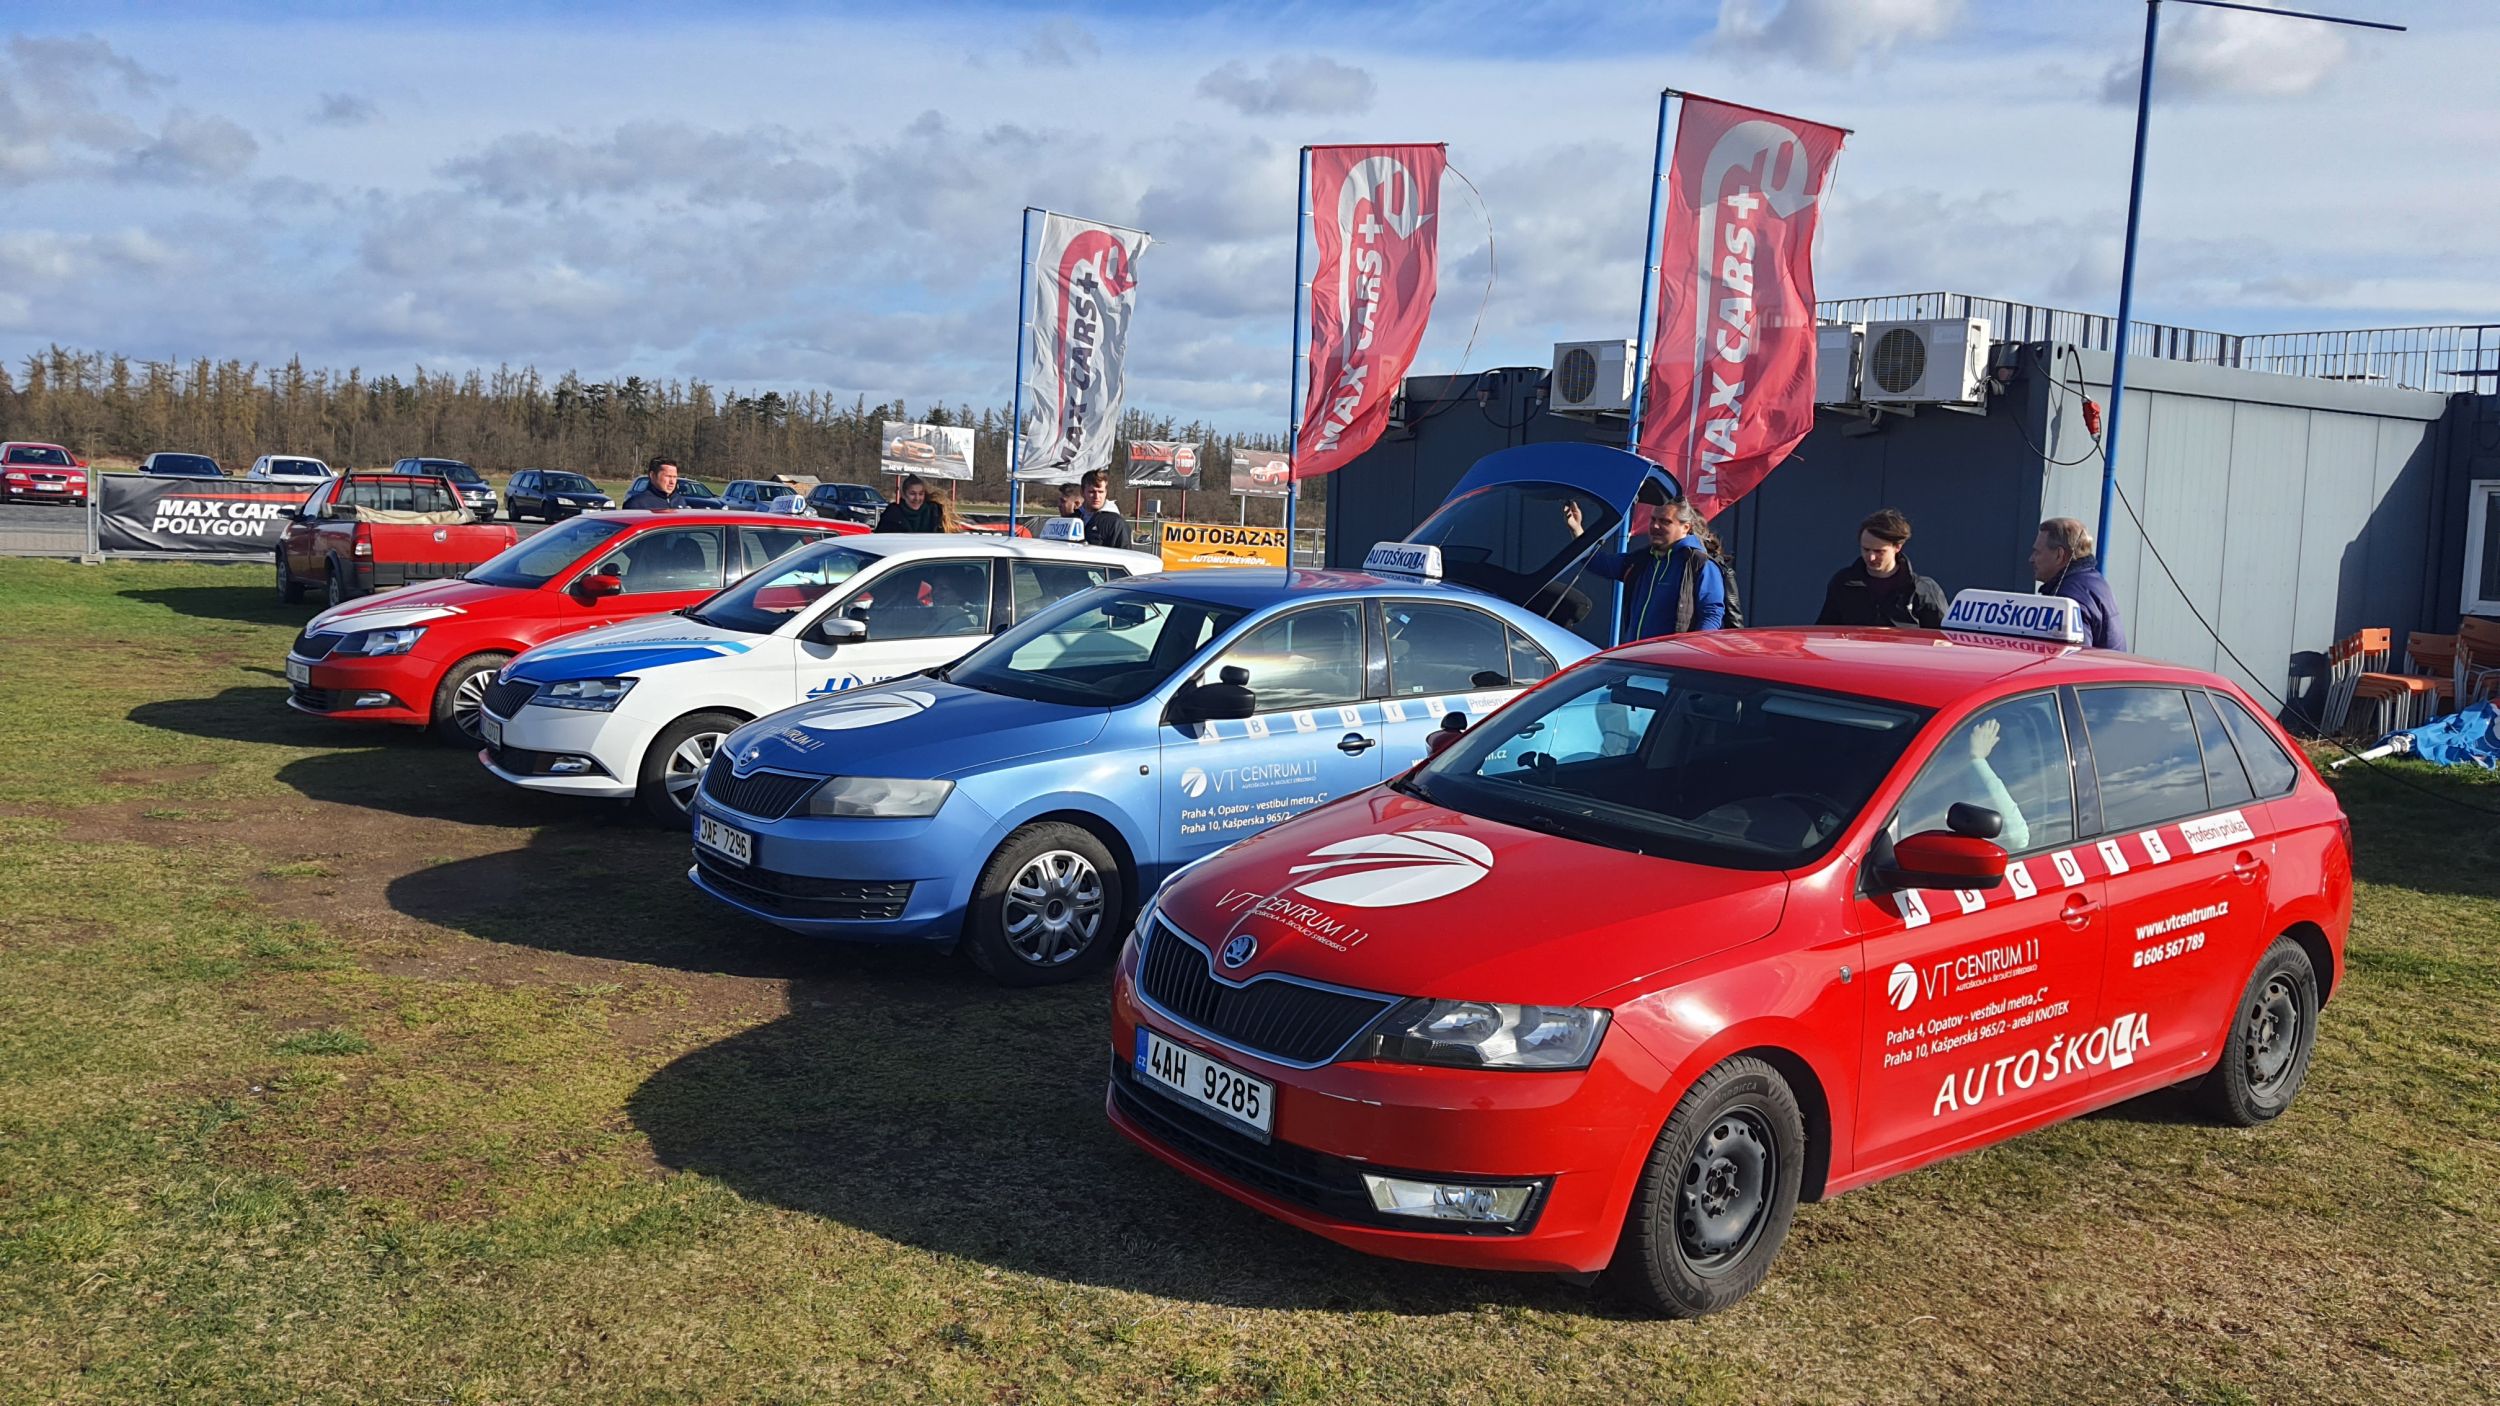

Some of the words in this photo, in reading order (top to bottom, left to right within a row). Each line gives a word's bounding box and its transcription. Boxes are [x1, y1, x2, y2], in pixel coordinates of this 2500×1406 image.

[1314, 362, 1369, 452] MAX
[1049, 396, 1087, 471] MAX
[1696, 370, 1746, 495] MAX
[156, 499, 225, 518] MAX
[151, 517, 266, 537] POLYGON
[1165, 526, 1285, 547] MOTOBAZAR
[1367, 547, 1427, 571] AUTOŠKOLA
[1947, 599, 2064, 632] AUTOŠKOLA
[1345, 709, 1356, 722] D
[1390, 704, 1400, 718] T
[1432, 701, 1441, 713] E
[1250, 721, 1262, 733] B
[1299, 713, 1311, 727] C
[1211, 768, 1239, 793] VT
[1240, 761, 1302, 782] CENTRUM
[1305, 759, 1318, 775] 11
[1181, 808, 1207, 820] Praha
[1208, 806, 1216, 817] 4,
[1217, 802, 1250, 816] Opatov
[1256, 796, 1289, 810] vestibul
[1181, 823, 1206, 835] Praha
[1208, 821, 1221, 832] 10,
[723, 828, 747, 858] 7296
[2149, 837, 2162, 855] E
[2058, 857, 2076, 878] D
[2103, 846, 2122, 866] T
[2012, 867, 2029, 889] C
[1905, 895, 1922, 918] A
[1960, 888, 1975, 904] B
[1215, 888, 1264, 912] VT
[1255, 895, 1346, 938] CENTRUM
[1341, 928, 1369, 947] 11
[2136, 901, 2229, 941] www.vtcentrum.cz
[2143, 943, 2165, 966] 606
[2164, 937, 2186, 960] 567
[2185, 931, 2205, 953] 789
[1921, 960, 1954, 1001] VT
[1955, 943, 2023, 981] CENTRUM
[2025, 938, 2040, 963] 11
[1886, 1027, 1915, 1046] Praha
[1916, 1027, 1926, 1039] 4,
[1927, 1013, 1964, 1035] Opatov
[1970, 997, 2007, 1022] vestibul
[1884, 1048, 1913, 1069] Praha
[1915, 1044, 1928, 1059] 10,
[1931, 1029, 1978, 1054] Kašperská
[1980, 1020, 2006, 1041] 965/2
[2012, 1009, 2034, 1030] areál
[2034, 999, 2070, 1021] KNOTEK
[1137, 1055, 1146, 1068] CZ
[1932, 1012, 2151, 1117] AUTOŠKOLA
[1151, 1040, 1187, 1089] 4AH
[1203, 1065, 1260, 1120] 9285
